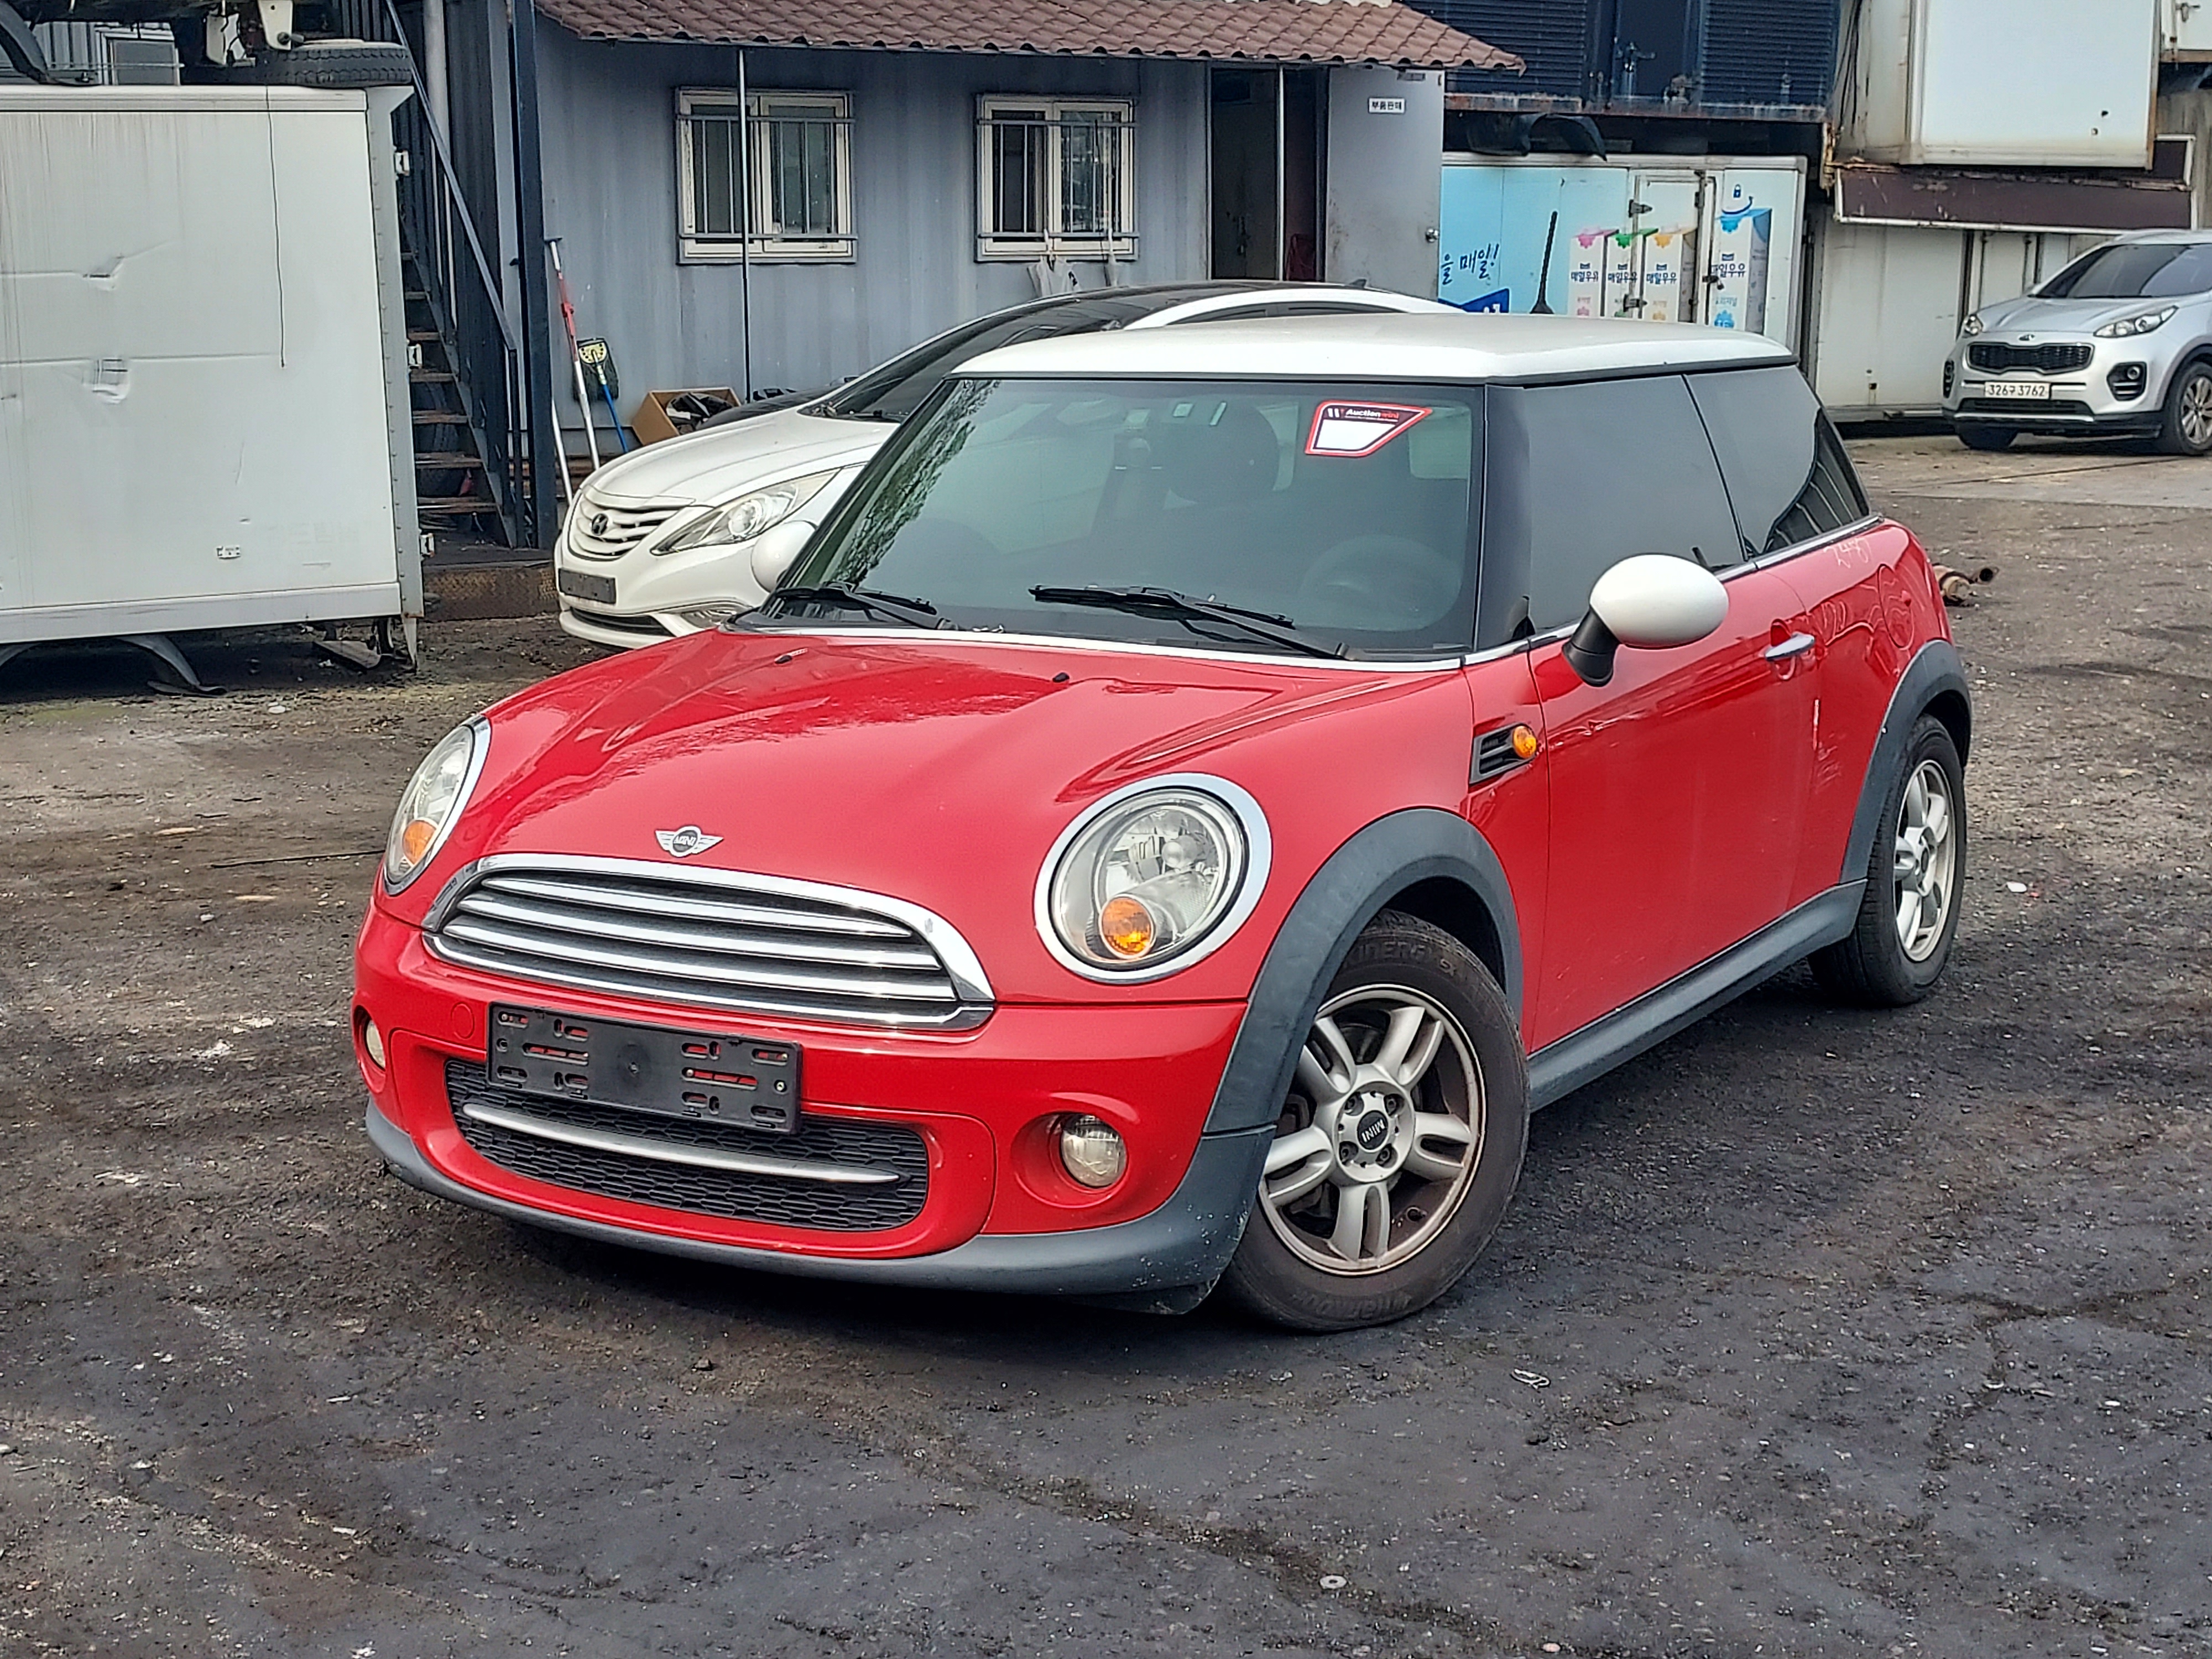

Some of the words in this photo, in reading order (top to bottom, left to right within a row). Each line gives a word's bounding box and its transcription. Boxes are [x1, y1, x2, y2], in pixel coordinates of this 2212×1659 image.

[1459, 243, 1499, 279] 매일!
[2018, 385, 2045, 397] 3762
[1361, 1118, 1386, 1143] MINI
